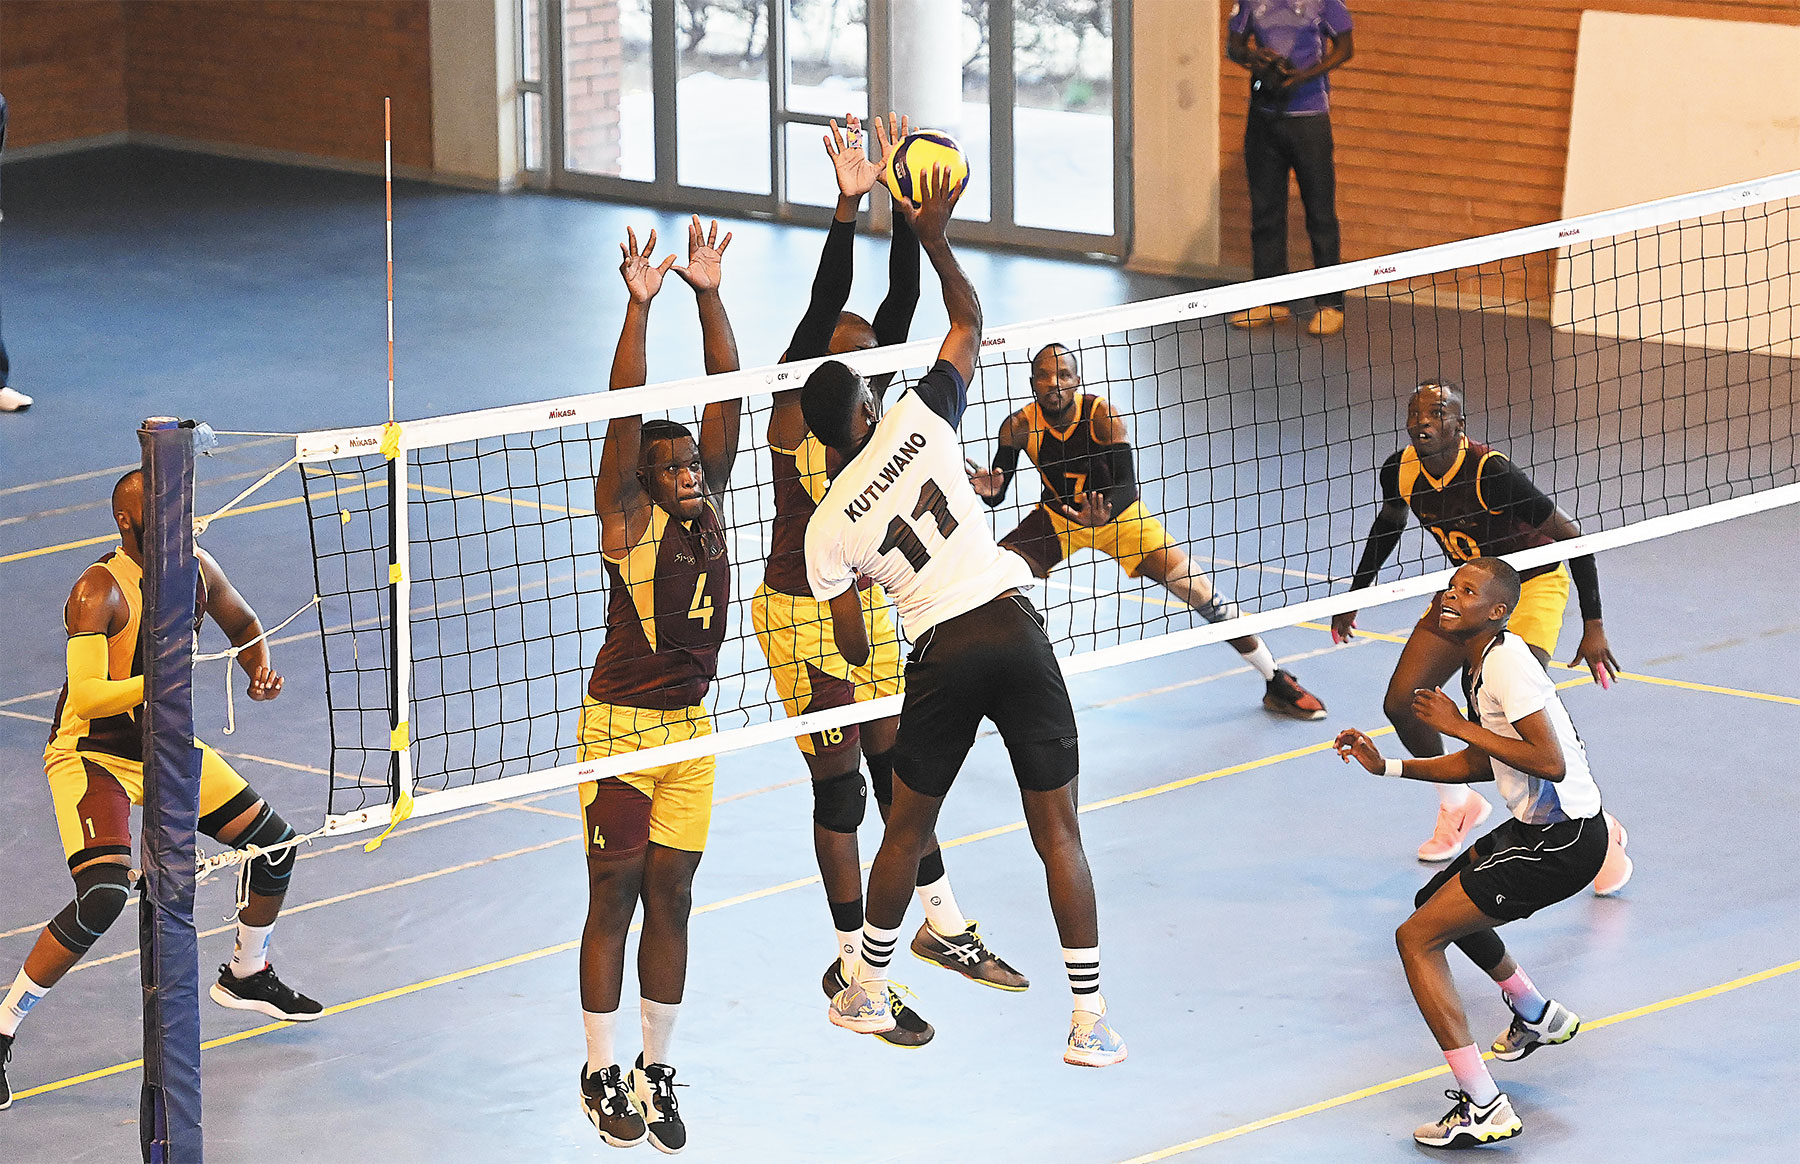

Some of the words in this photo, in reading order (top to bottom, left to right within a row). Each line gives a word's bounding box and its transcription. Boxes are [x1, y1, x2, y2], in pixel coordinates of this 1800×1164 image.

[844, 432, 927, 523] KUTLWANO
[1064, 472, 1087, 503] 7
[877, 477, 959, 574] 11
[687, 571, 715, 630] 4
[820, 727, 844, 747] 18
[85, 817, 96, 839] 1
[593, 825, 606, 849] 4
